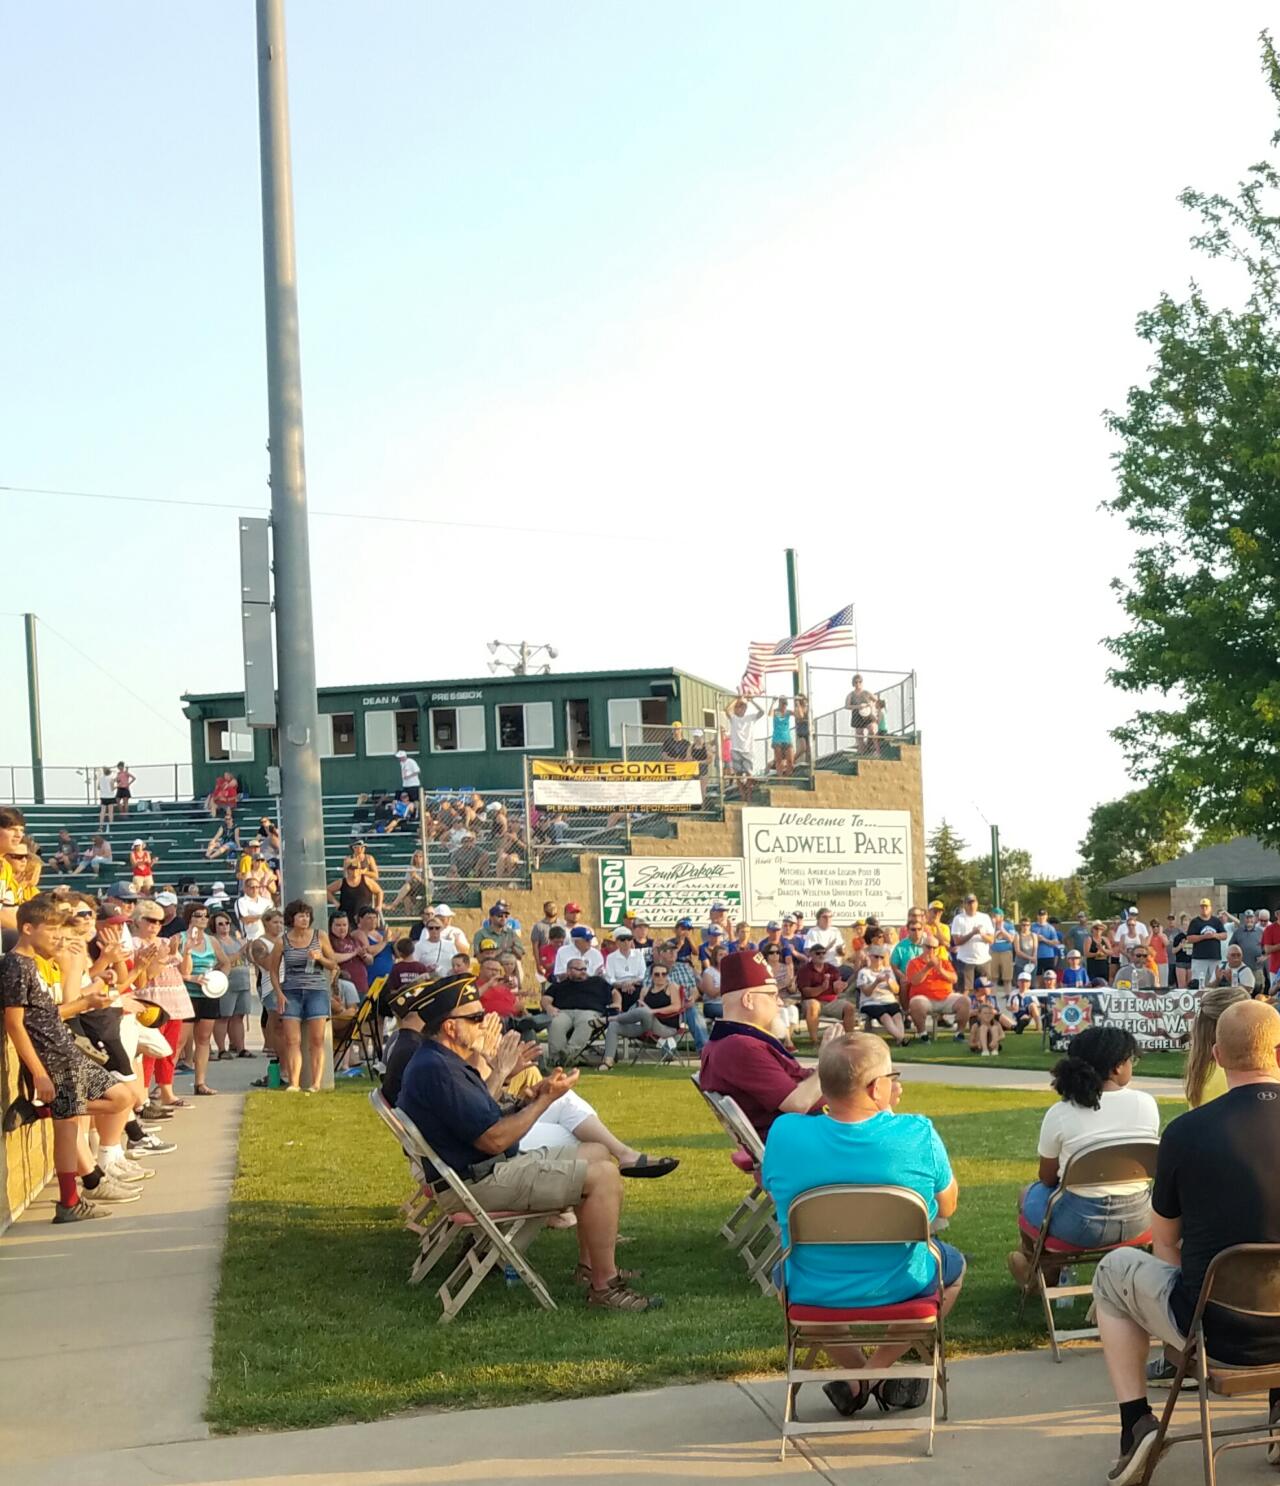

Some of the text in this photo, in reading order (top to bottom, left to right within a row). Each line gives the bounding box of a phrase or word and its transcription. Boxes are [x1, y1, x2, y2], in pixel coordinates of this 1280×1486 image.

[362, 696, 389, 705] DEAN
[431, 691, 483, 701] PRESSBOX
[558, 763, 677, 775] WELCOME
[778, 812, 846, 827] Welcome
[754, 829, 904, 855] CADWELL PARK
[673, 861, 735, 884] Dakota
[864, 878, 881, 886] 2750
[642, 890, 728, 899] BASEBALL
[1097, 994, 1173, 1013] VETERANS
[1094, 1014, 1194, 1034] FOREIGN WA
[1137, 1039, 1185, 1050] ITCHELL,
